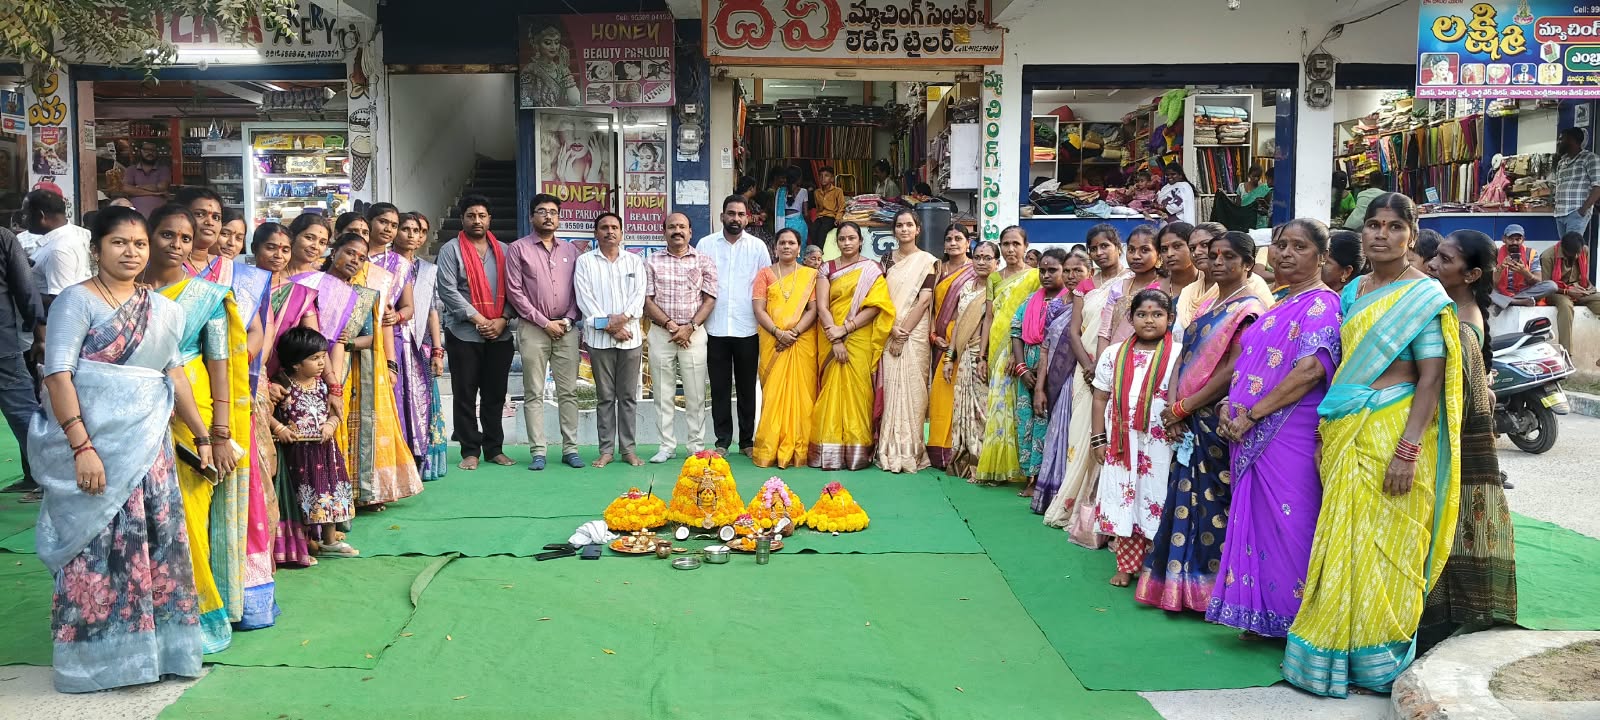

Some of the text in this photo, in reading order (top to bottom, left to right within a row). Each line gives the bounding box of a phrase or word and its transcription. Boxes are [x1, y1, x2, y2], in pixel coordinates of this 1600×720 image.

[591, 22, 660, 45] HONEY
[584, 46, 670, 59] BEAUTY PARLOUR
[544, 182, 607, 208] HONEY
[626, 195, 665, 211] HONEY
[629, 212, 662, 221] BEAUTY
